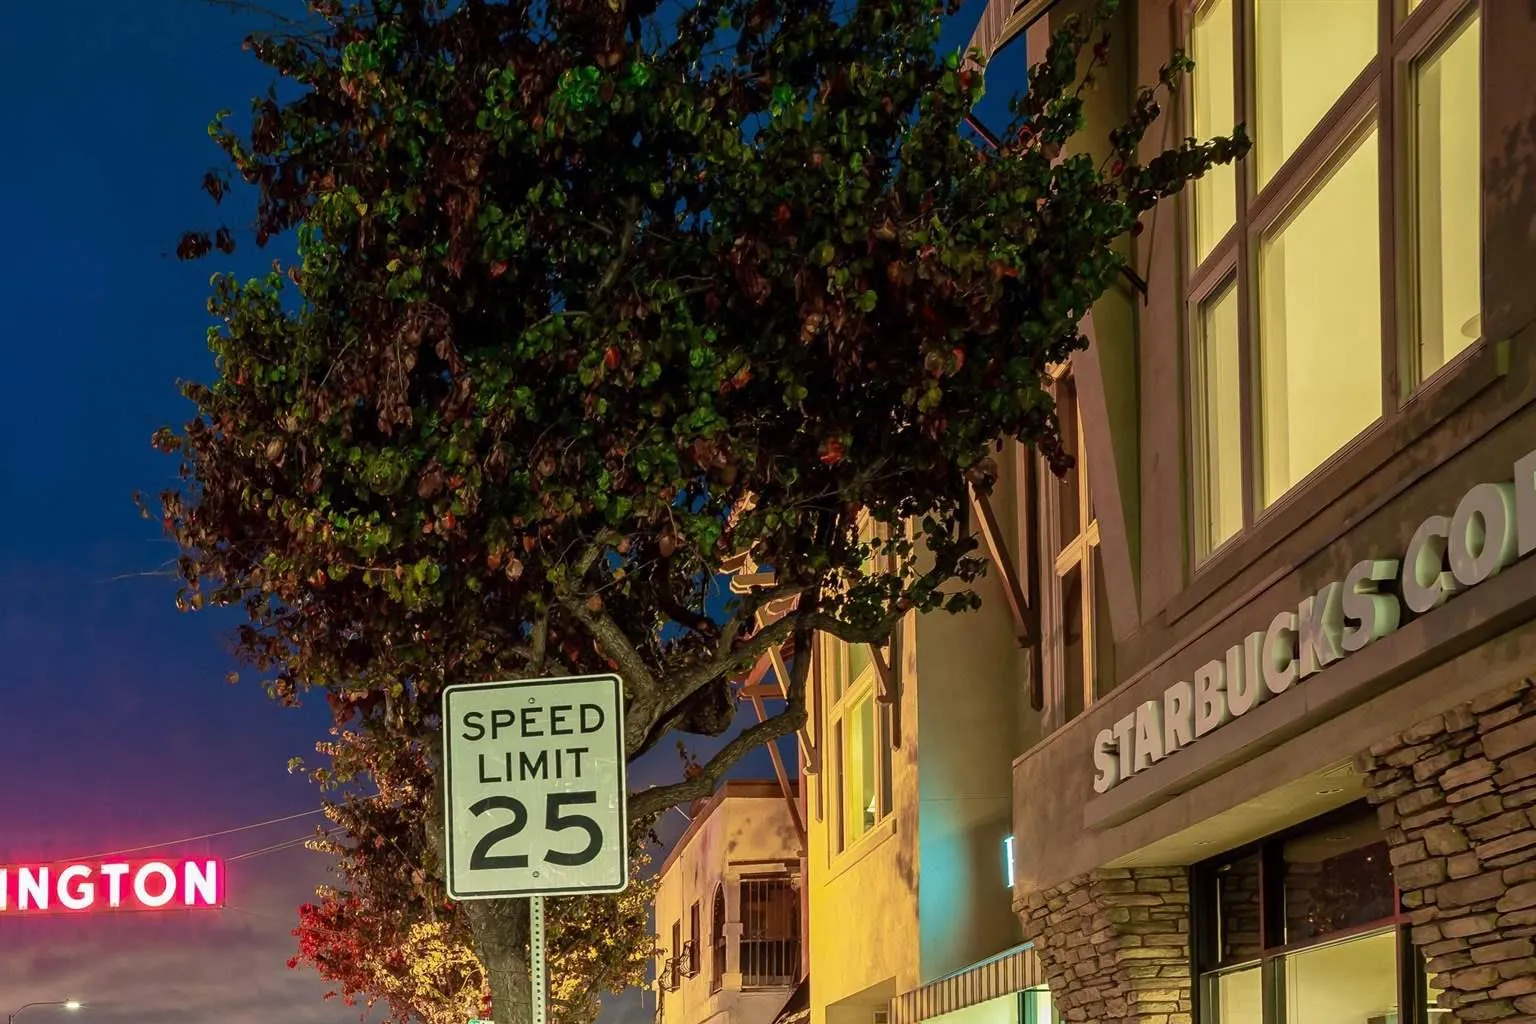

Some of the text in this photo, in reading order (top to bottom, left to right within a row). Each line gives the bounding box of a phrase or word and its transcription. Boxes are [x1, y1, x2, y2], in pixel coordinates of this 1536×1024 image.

[1093, 559, 1401, 794] STARBUCKS
[462, 703, 605, 741] SPEED
[478, 747, 589, 783] LIMIT
[468, 790, 604, 870] 25
